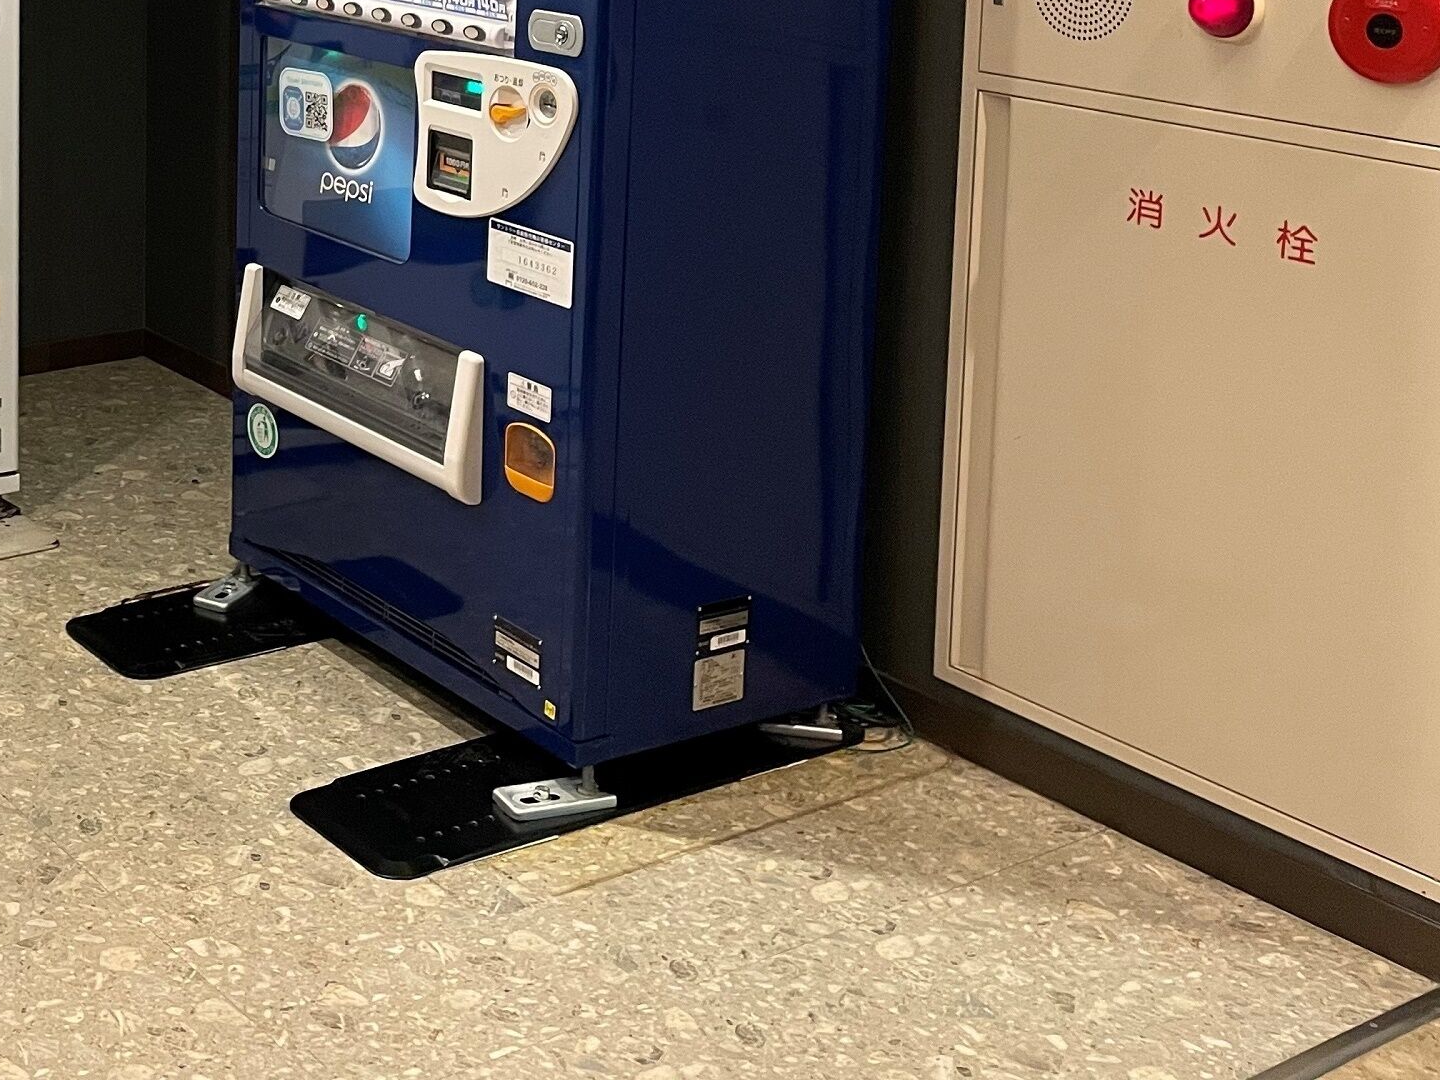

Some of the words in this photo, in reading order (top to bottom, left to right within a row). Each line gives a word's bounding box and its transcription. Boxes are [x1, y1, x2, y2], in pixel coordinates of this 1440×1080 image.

[320, 172, 374, 204] pepsi
[1126, 187, 1319, 265] 消火栓
